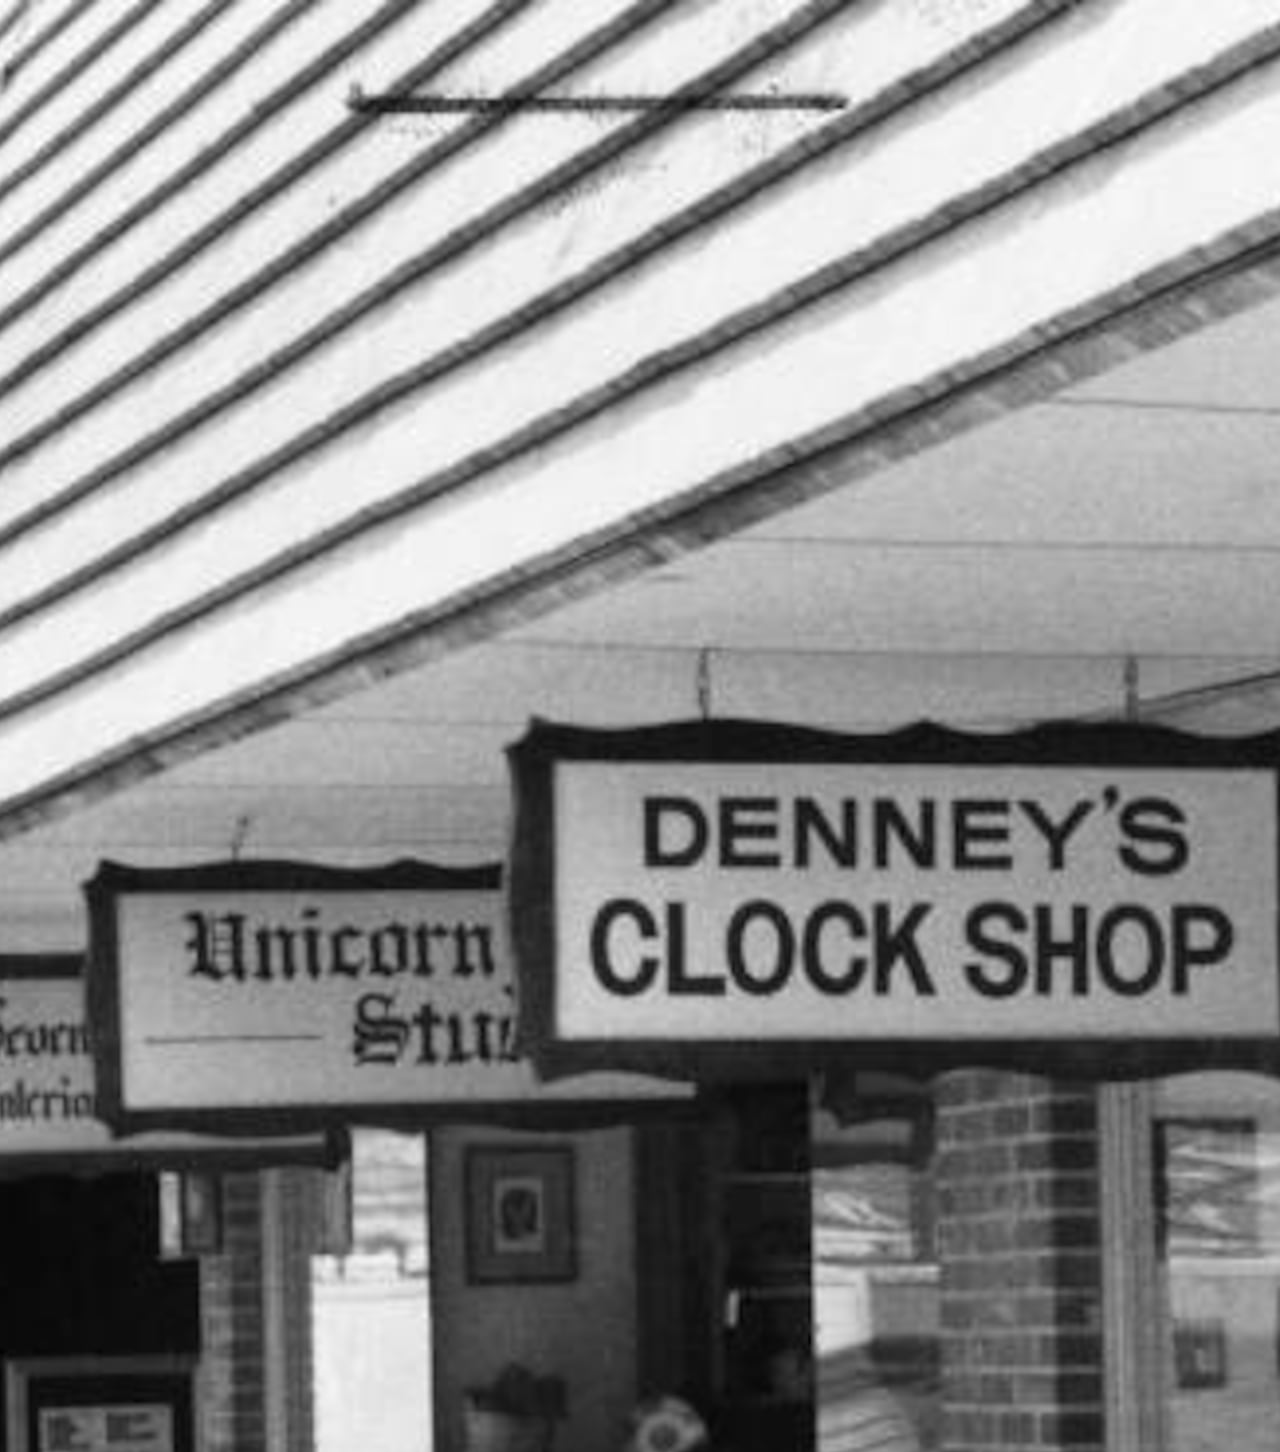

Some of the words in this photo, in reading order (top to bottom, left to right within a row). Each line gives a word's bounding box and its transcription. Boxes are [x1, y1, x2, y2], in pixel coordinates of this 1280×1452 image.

[642, 785, 1191, 877] DENNEY'S
[183, 907, 497, 983] Unicorn
[589, 899, 936, 997] CLOCK
[963, 901, 1236, 1000] SHOP
